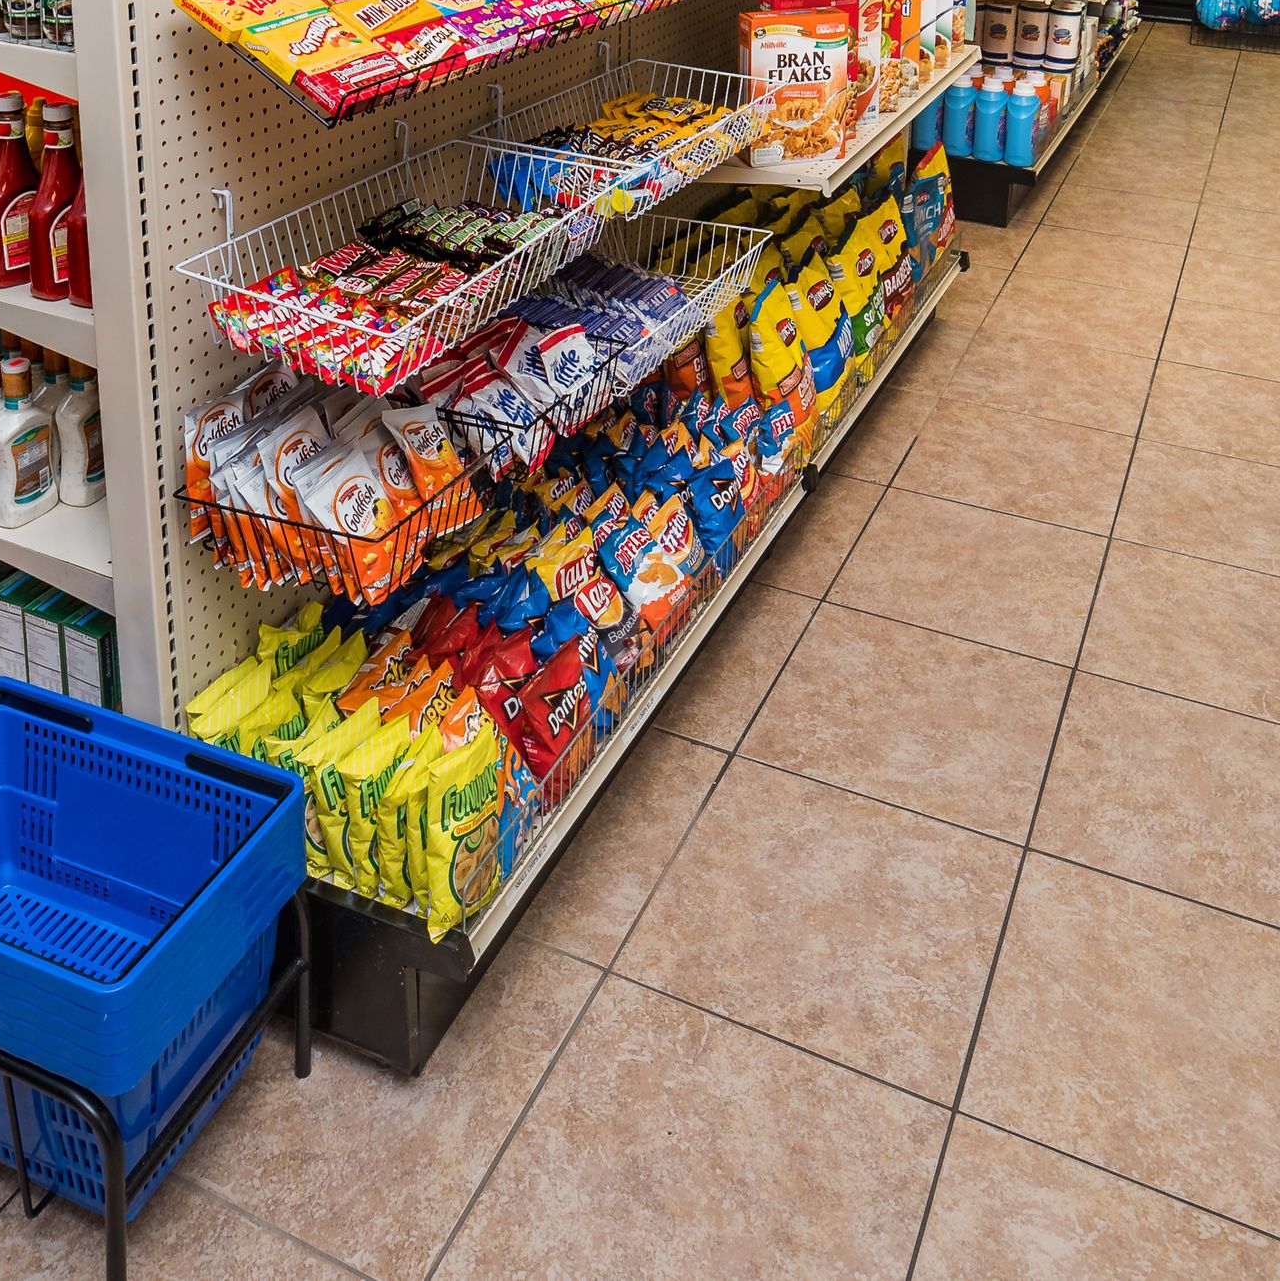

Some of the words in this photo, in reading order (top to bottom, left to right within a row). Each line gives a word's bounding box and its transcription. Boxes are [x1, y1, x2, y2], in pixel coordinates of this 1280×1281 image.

[200, 11, 224, 33] BABIES
[355, 4, 392, 30] Milk
[474, 15, 525, 40] Spree
[406, 40, 438, 67] CHERRY
[435, 26, 457, 46] COLA
[761, 42, 787, 50] Millville
[777, 50, 825, 69] BRAN
[768, 65, 832, 85] FLAKES
[315, 243, 367, 277] TWIX
[418, 270, 469, 301] TWIX
[807, 280, 835, 311] Clancy's
[197, 413, 242, 459] Goldfish
[346, 484, 376, 536] Goldfish
[660, 511, 690, 554] Fritos
[613, 528, 652, 575] RUFFLES
[556, 550, 597, 595] Lay's
[581, 577, 613, 613] Lay's
[548, 675, 588, 737] Doritos
